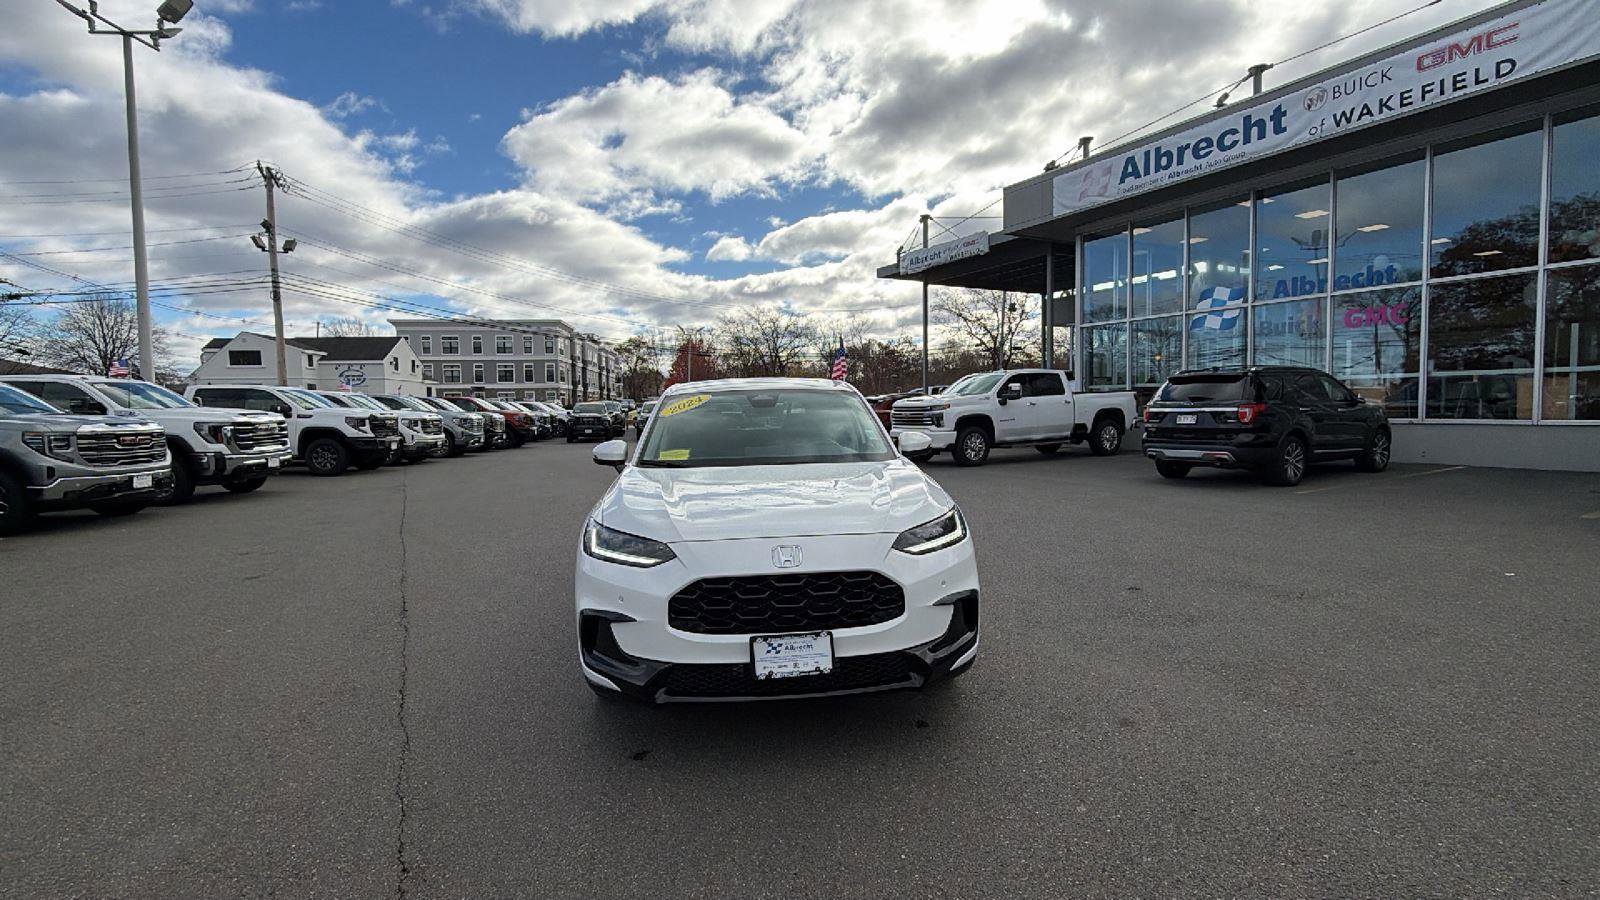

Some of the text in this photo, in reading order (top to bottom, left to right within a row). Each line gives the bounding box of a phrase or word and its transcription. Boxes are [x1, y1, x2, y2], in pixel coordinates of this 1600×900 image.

[1416, 22, 1519, 73] GMC
[1308, 58, 1518, 137] of WAKEFIELD
[1332, 66, 1393, 100] BUICK
[1118, 104, 1288, 186] Albrecht
[1168, 163, 1203, 180] Albrecht
[1273, 264, 1399, 298] Albrecht
[1344, 302, 1409, 328] GMC
[669, 396, 703, 414] 2024
